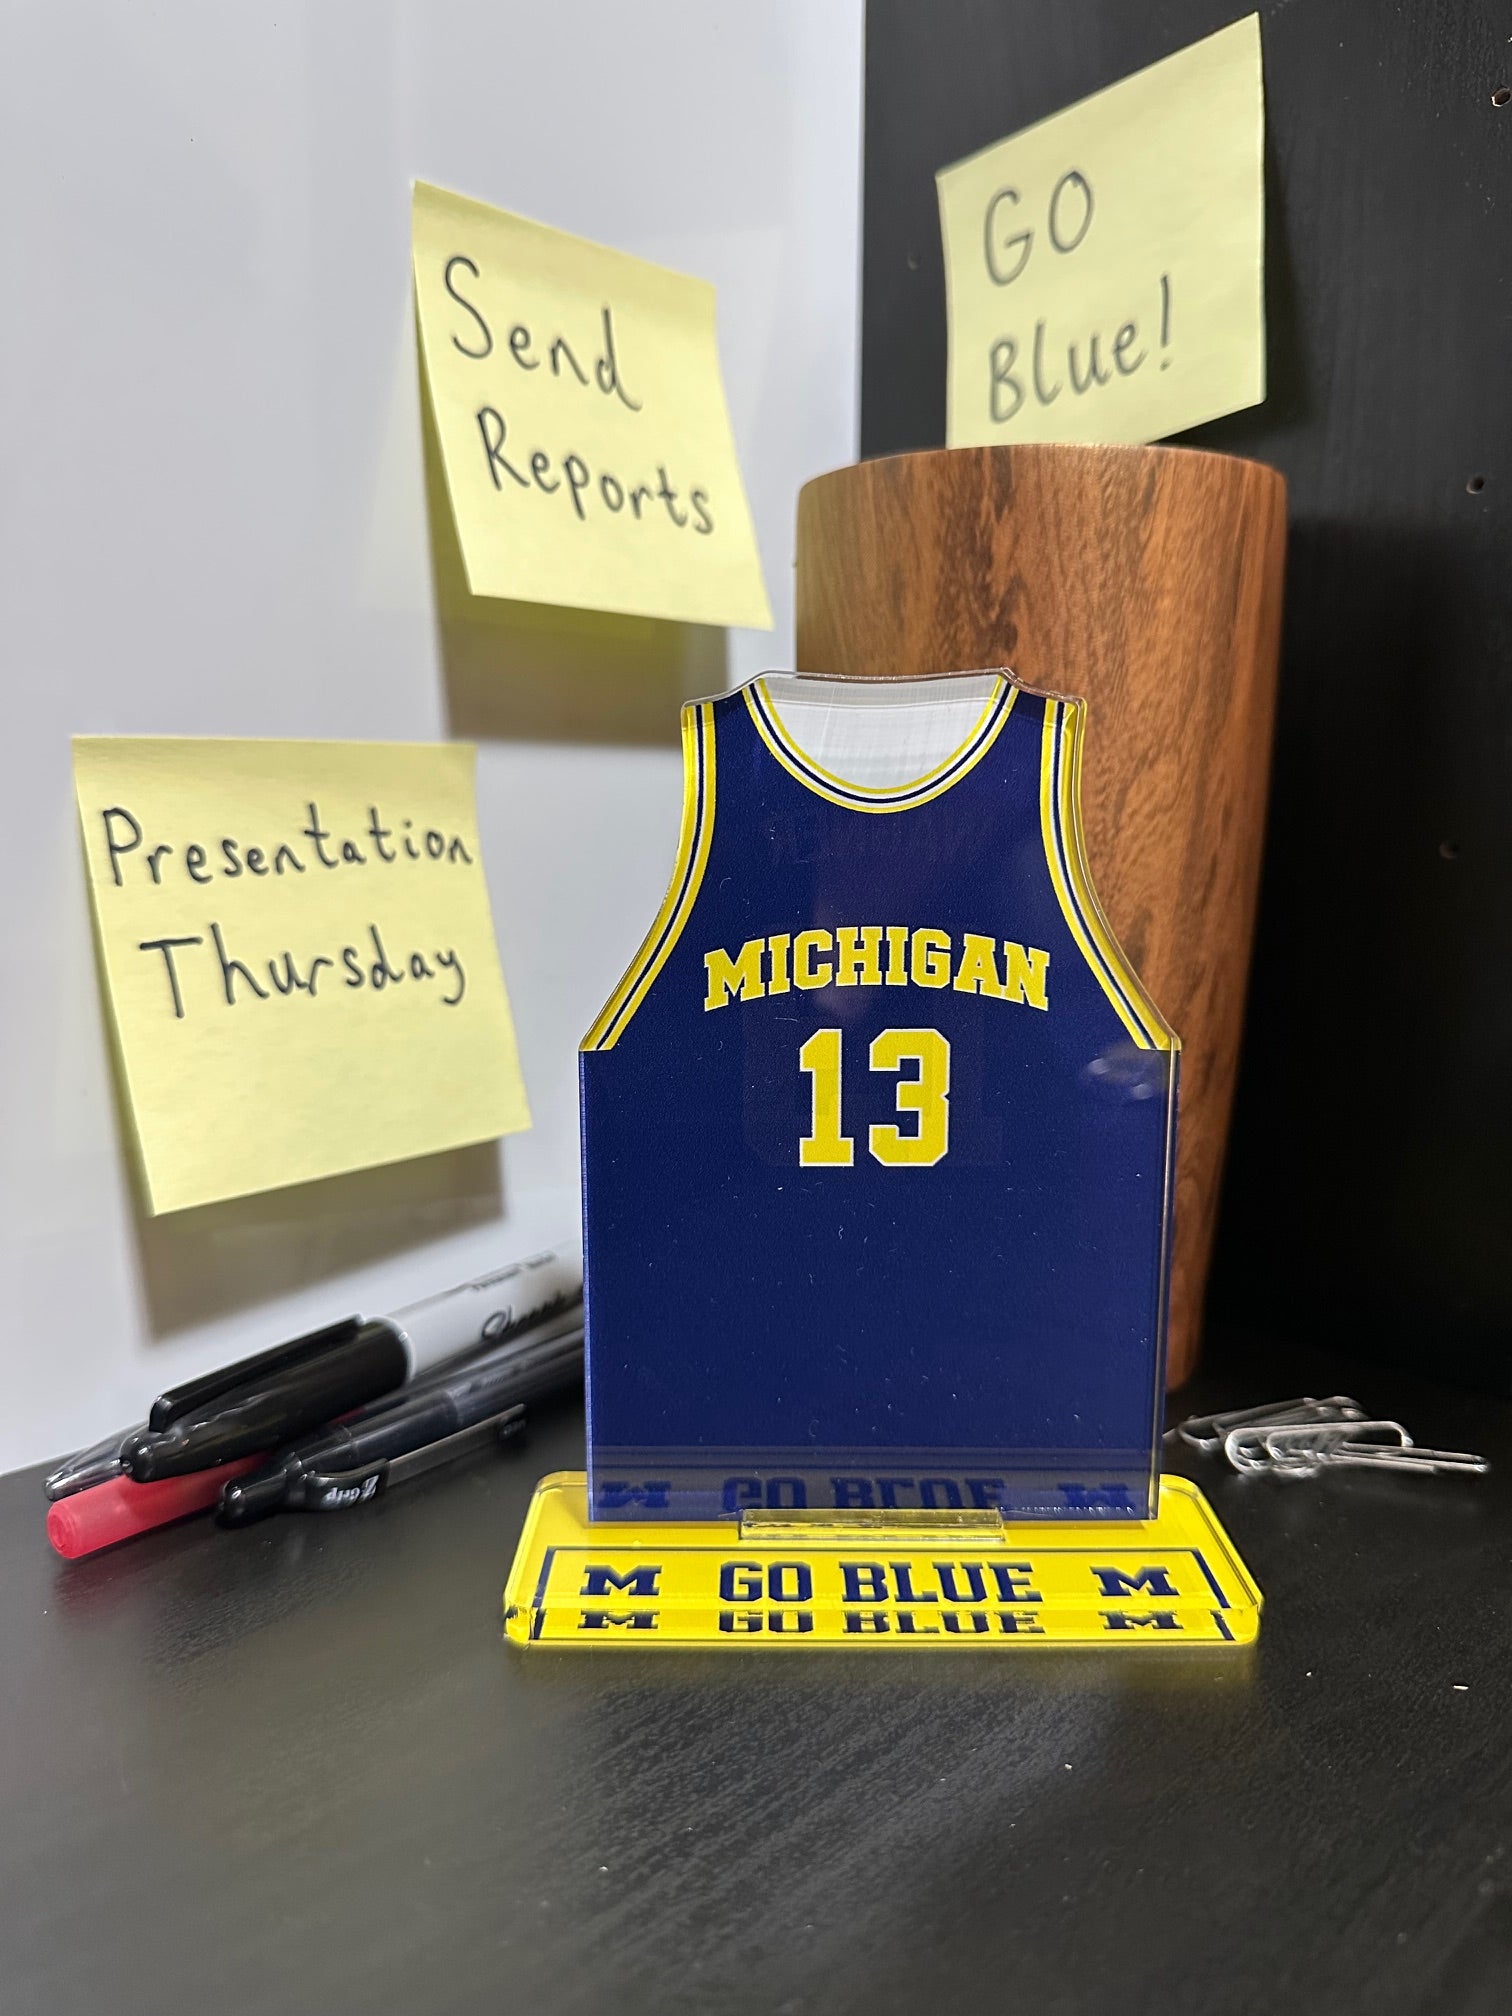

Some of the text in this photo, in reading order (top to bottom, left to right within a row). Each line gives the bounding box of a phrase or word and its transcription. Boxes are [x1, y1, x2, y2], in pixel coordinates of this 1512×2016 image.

[983, 169, 1095, 287] GO
[443, 255, 643, 412] Send
[988, 272, 1171, 425] Blue!
[475, 405, 715, 536] Reports
[101, 801, 474, 888] Presentation
[138, 921, 467, 1019] Thursday
[703, 925, 1051, 1013] MICHIGAN
[799, 1028, 951, 1168] 13
[579, 1560, 1181, 1603] M GO BLUE M
